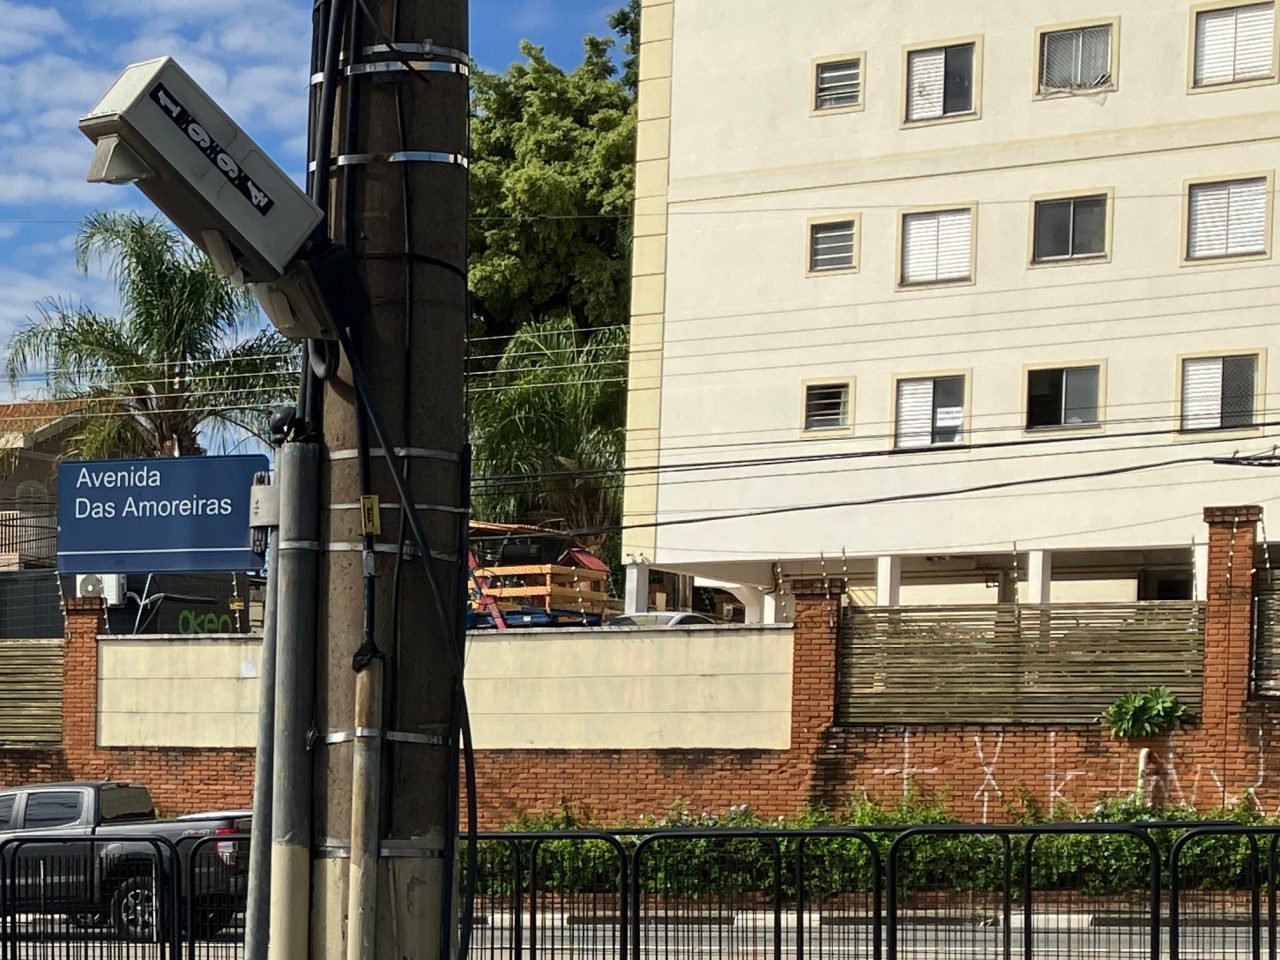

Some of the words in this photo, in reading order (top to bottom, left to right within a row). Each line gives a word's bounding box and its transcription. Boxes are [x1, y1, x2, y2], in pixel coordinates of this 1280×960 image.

[76, 466, 160, 488] Avenida
[75, 497, 115, 519] Das
[122, 494, 232, 518] Amoreiras
